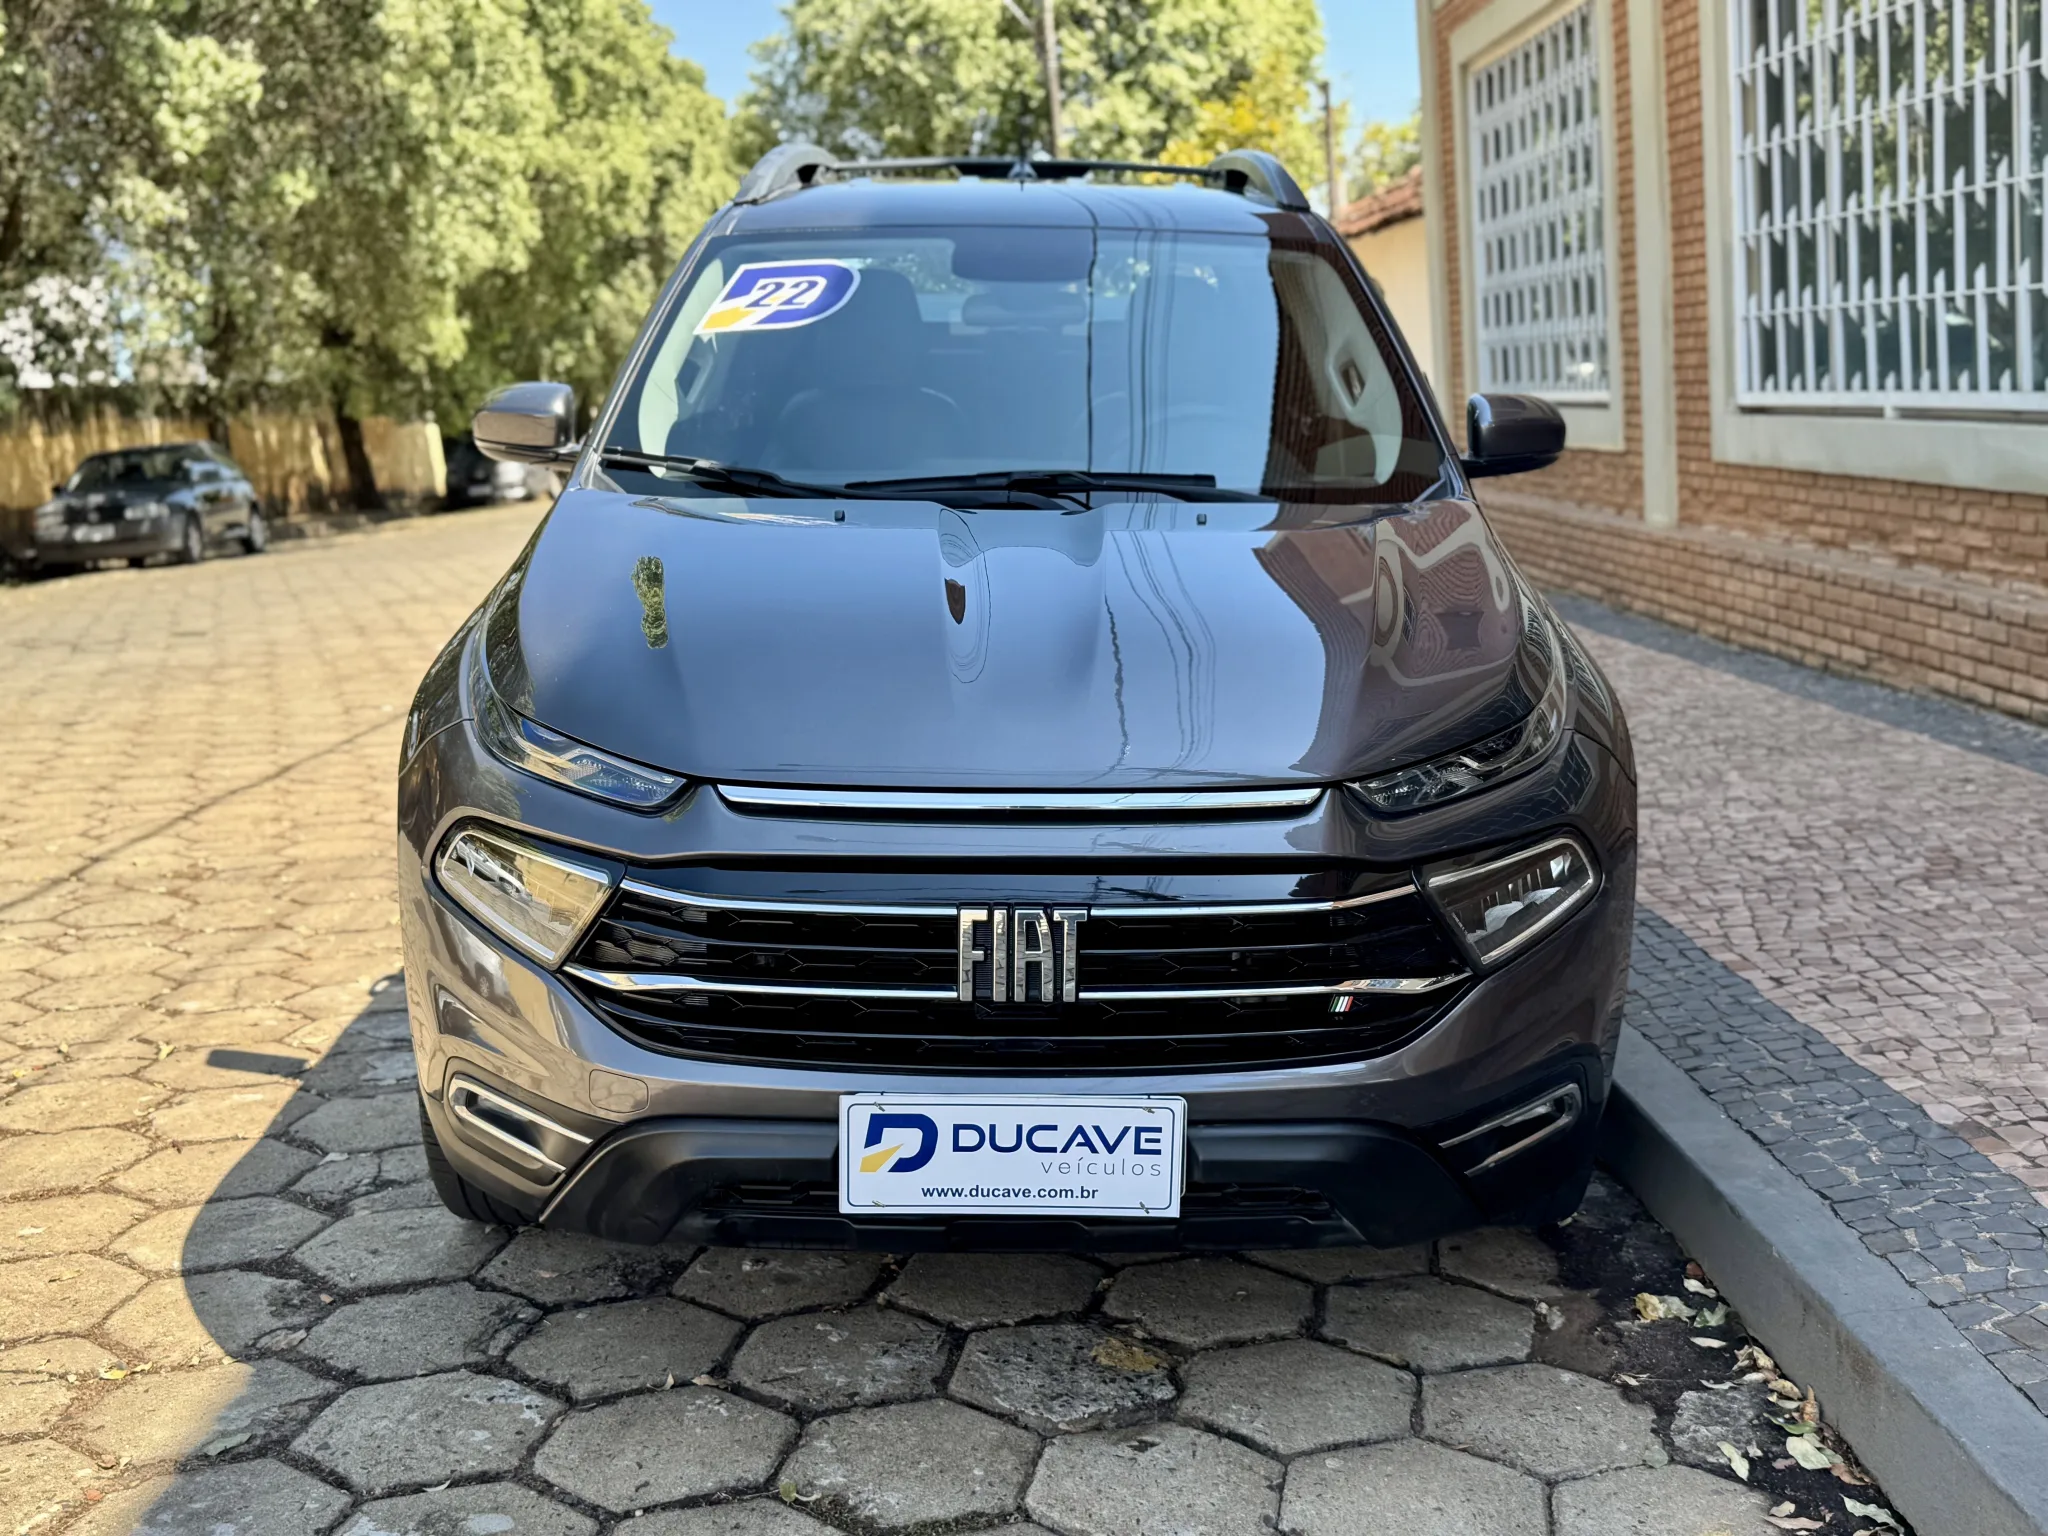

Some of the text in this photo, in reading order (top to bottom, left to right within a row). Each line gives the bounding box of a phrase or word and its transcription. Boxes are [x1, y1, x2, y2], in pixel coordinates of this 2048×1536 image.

[744, 279, 819, 308] 22
[959, 908, 1088, 1002] FIAT
[952, 1123, 1163, 1156] DUCAVE
[1041, 1156, 1162, 1177] veículos
[921, 1185, 1099, 1200] www.ducave.com.br
